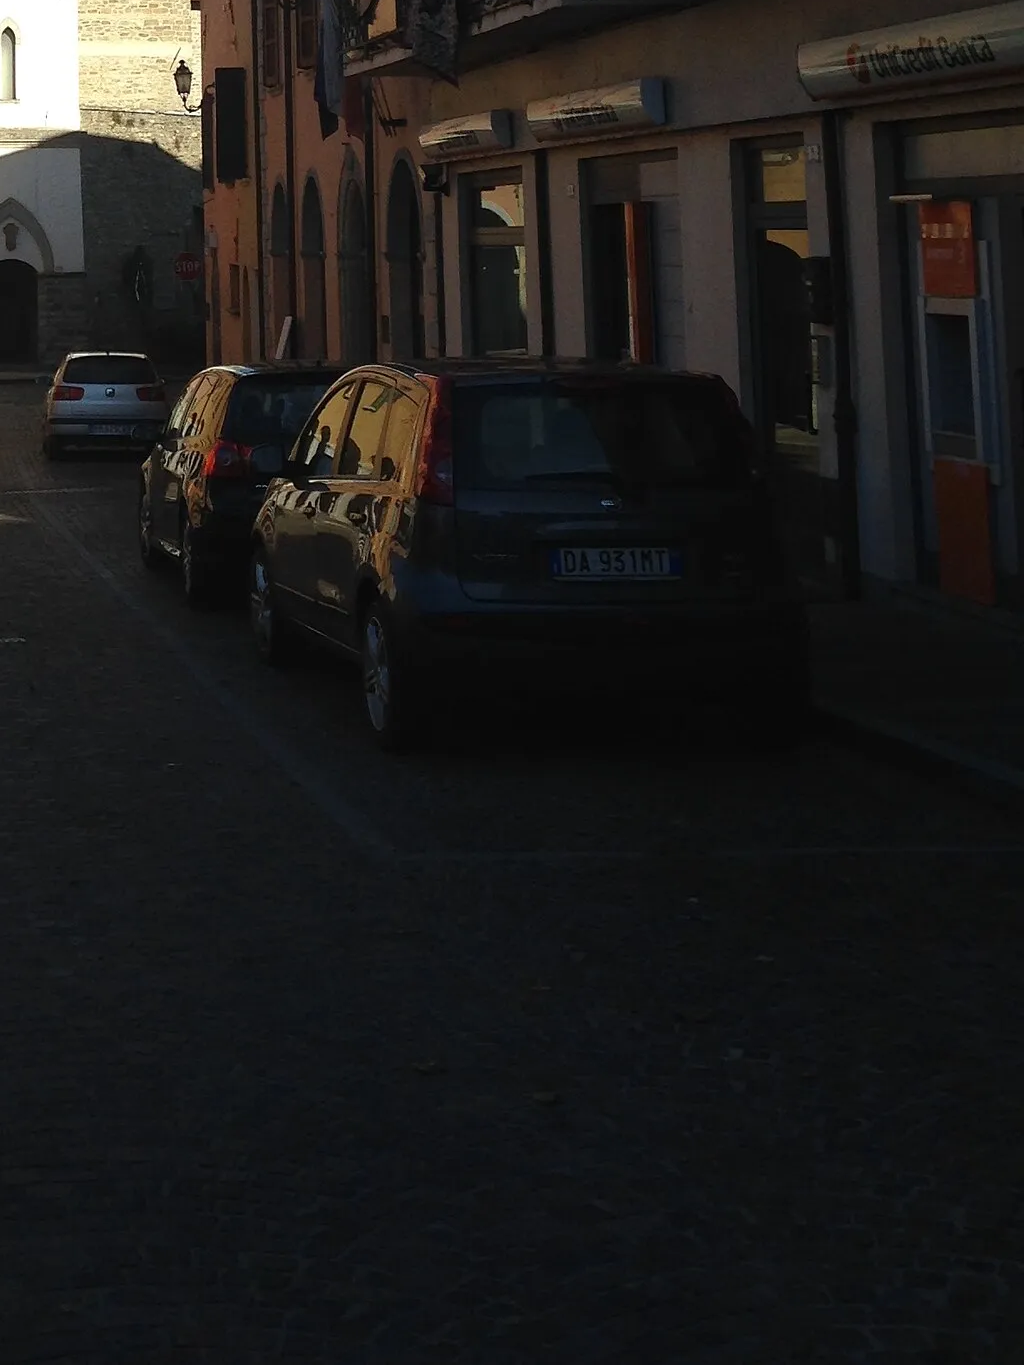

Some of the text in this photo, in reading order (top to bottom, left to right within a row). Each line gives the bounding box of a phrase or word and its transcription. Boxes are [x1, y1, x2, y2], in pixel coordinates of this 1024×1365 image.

[870, 34, 995, 77] UniCredit Banca
[175, 259, 201, 273] STOP
[564, 550, 590, 573] DA
